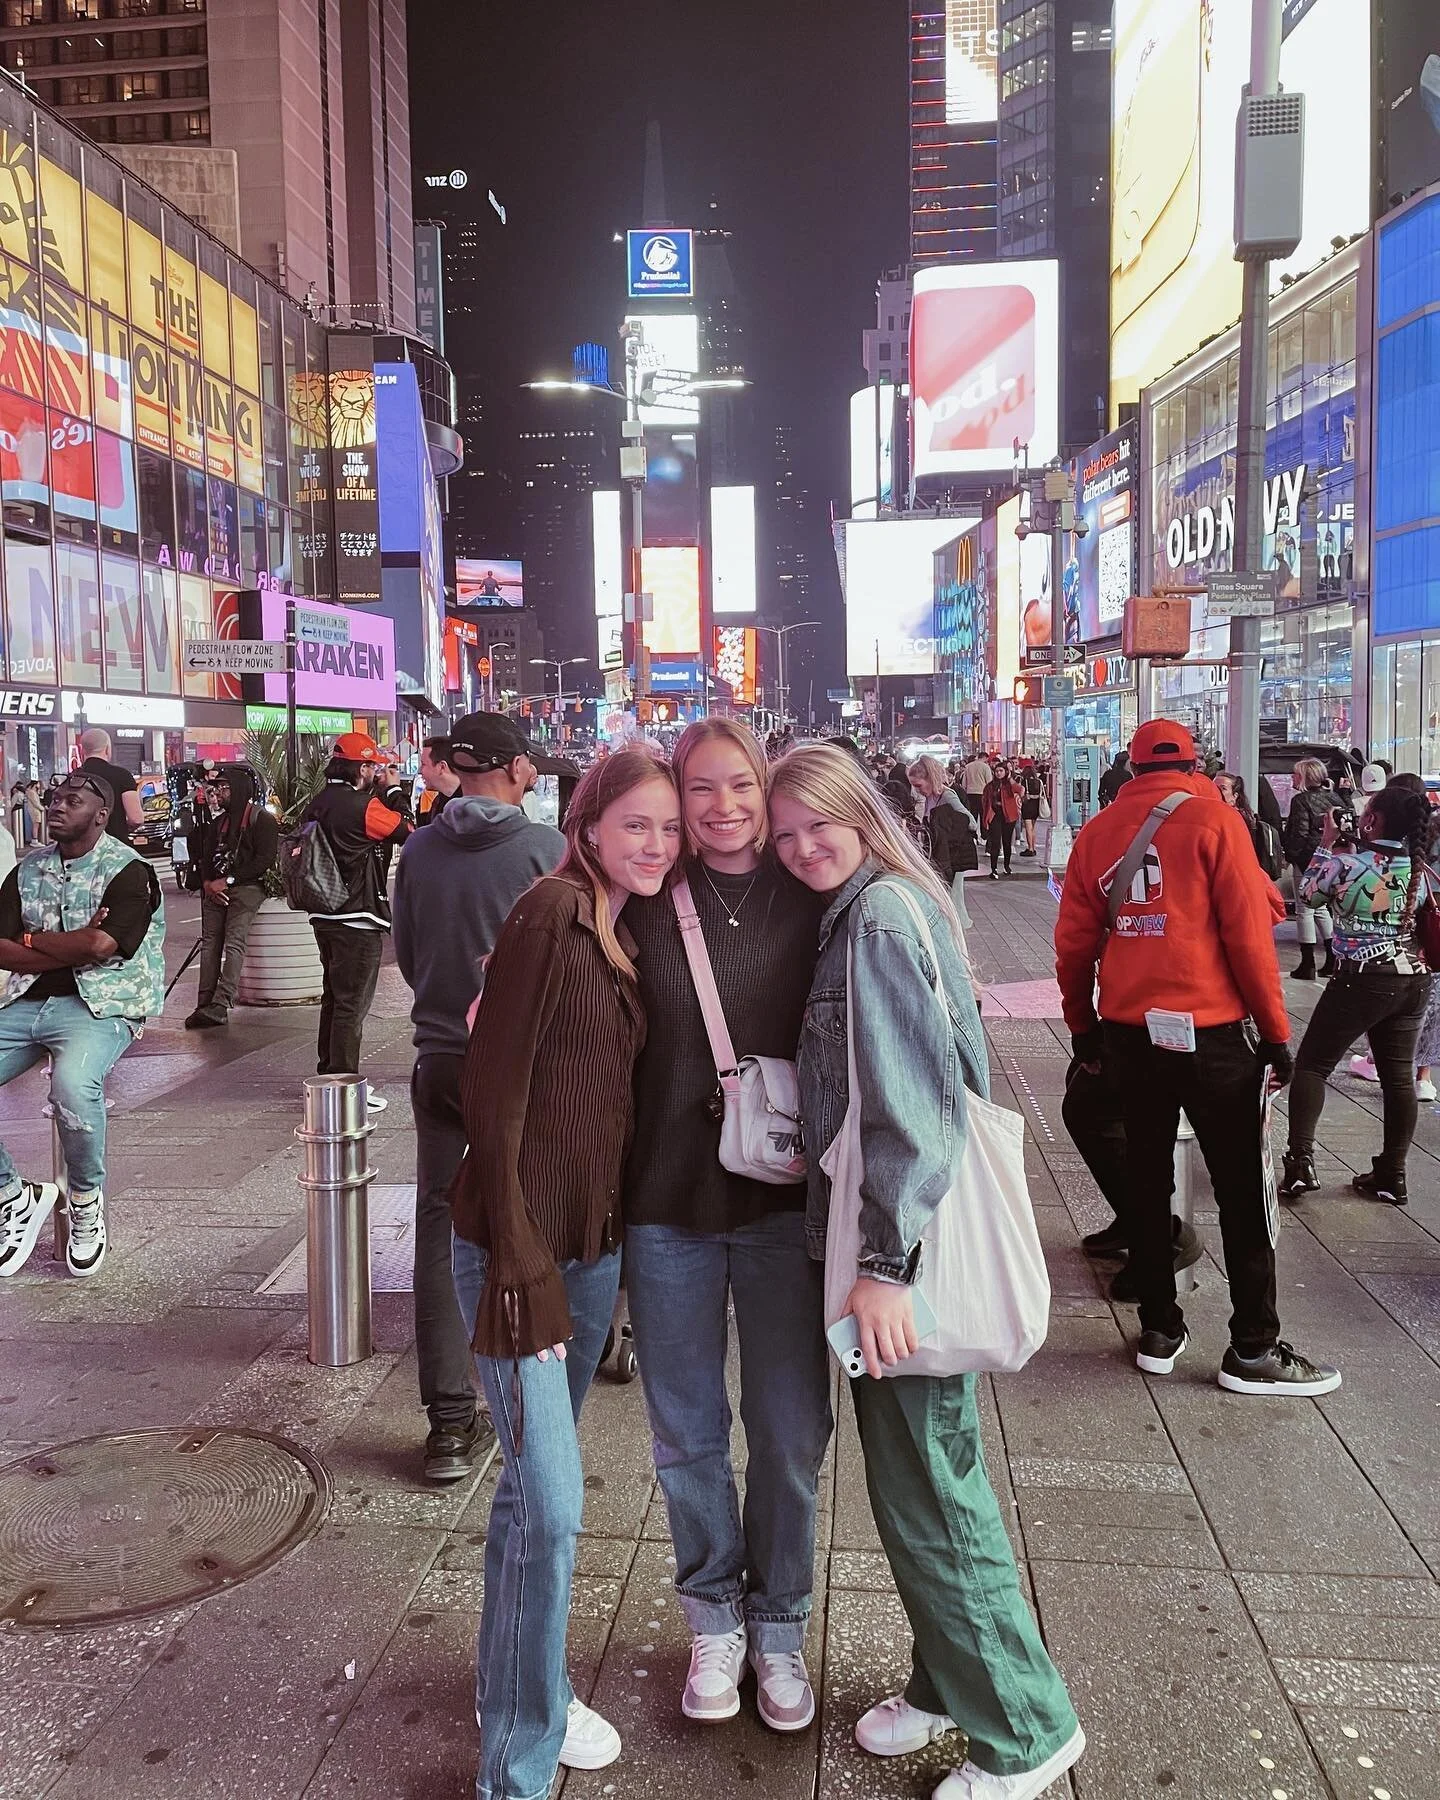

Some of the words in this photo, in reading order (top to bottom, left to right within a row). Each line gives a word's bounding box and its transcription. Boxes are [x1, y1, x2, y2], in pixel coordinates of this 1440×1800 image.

[641, 271, 681, 281] Prudential
[417, 242, 434, 349] TIMES
[150, 274, 197, 340] THE
[101, 297, 181, 411] LION
[184, 349, 253, 447] KING
[139, 427, 169, 448] ENTRANCE
[176, 443, 185, 454] ON
[188, 446, 202, 461] 45TH
[208, 459, 224, 471] STREET
[345, 452, 364, 464] THE
[1083, 459, 1100, 487] polar
[1101, 448, 1119, 472] bears
[1119, 438, 1130, 461] hit
[342, 464, 369, 477] SHOW
[346, 477, 357, 488] OF
[359, 477, 366, 488] A
[1083, 479, 1111, 504] different
[1112, 467, 1130, 488] here.
[336, 488, 376, 500] LIFETIME
[1167, 506, 1214, 568] OLD
[1221, 464, 1306, 551] NVY
[340, 532, 377, 541] チケットは
[340, 541, 377, 549] ここで入手
[344, 548, 374, 557] できます
[1211, 583, 1234, 591] Times
[1235, 582, 1264, 592] Square
[1252, 591, 1271, 599] Plaza
[29, 567, 170, 673] NEW
[300, 612, 325, 627] PEDESTRIAN
[325, 616, 337, 629] FLOW
[337, 617, 348, 630] ZONE
[323, 629, 332, 640] KEEP
[333, 630, 348, 642] MOVING
[188, 644, 231, 654] PEDESTRIAN
[232, 644, 252, 654] FLOW
[254, 645, 273, 655] ZONE
[1034, 651, 1051, 660] ONE
[225, 658, 242, 668] KEEP
[245, 658, 273, 669] MOVING
[651, 672, 690, 681] Prudential
[1089, 660, 1095, 687] I
[1210, 665, 1229, 686] OLD
[1116, 914, 1168, 931] OPVIEW
